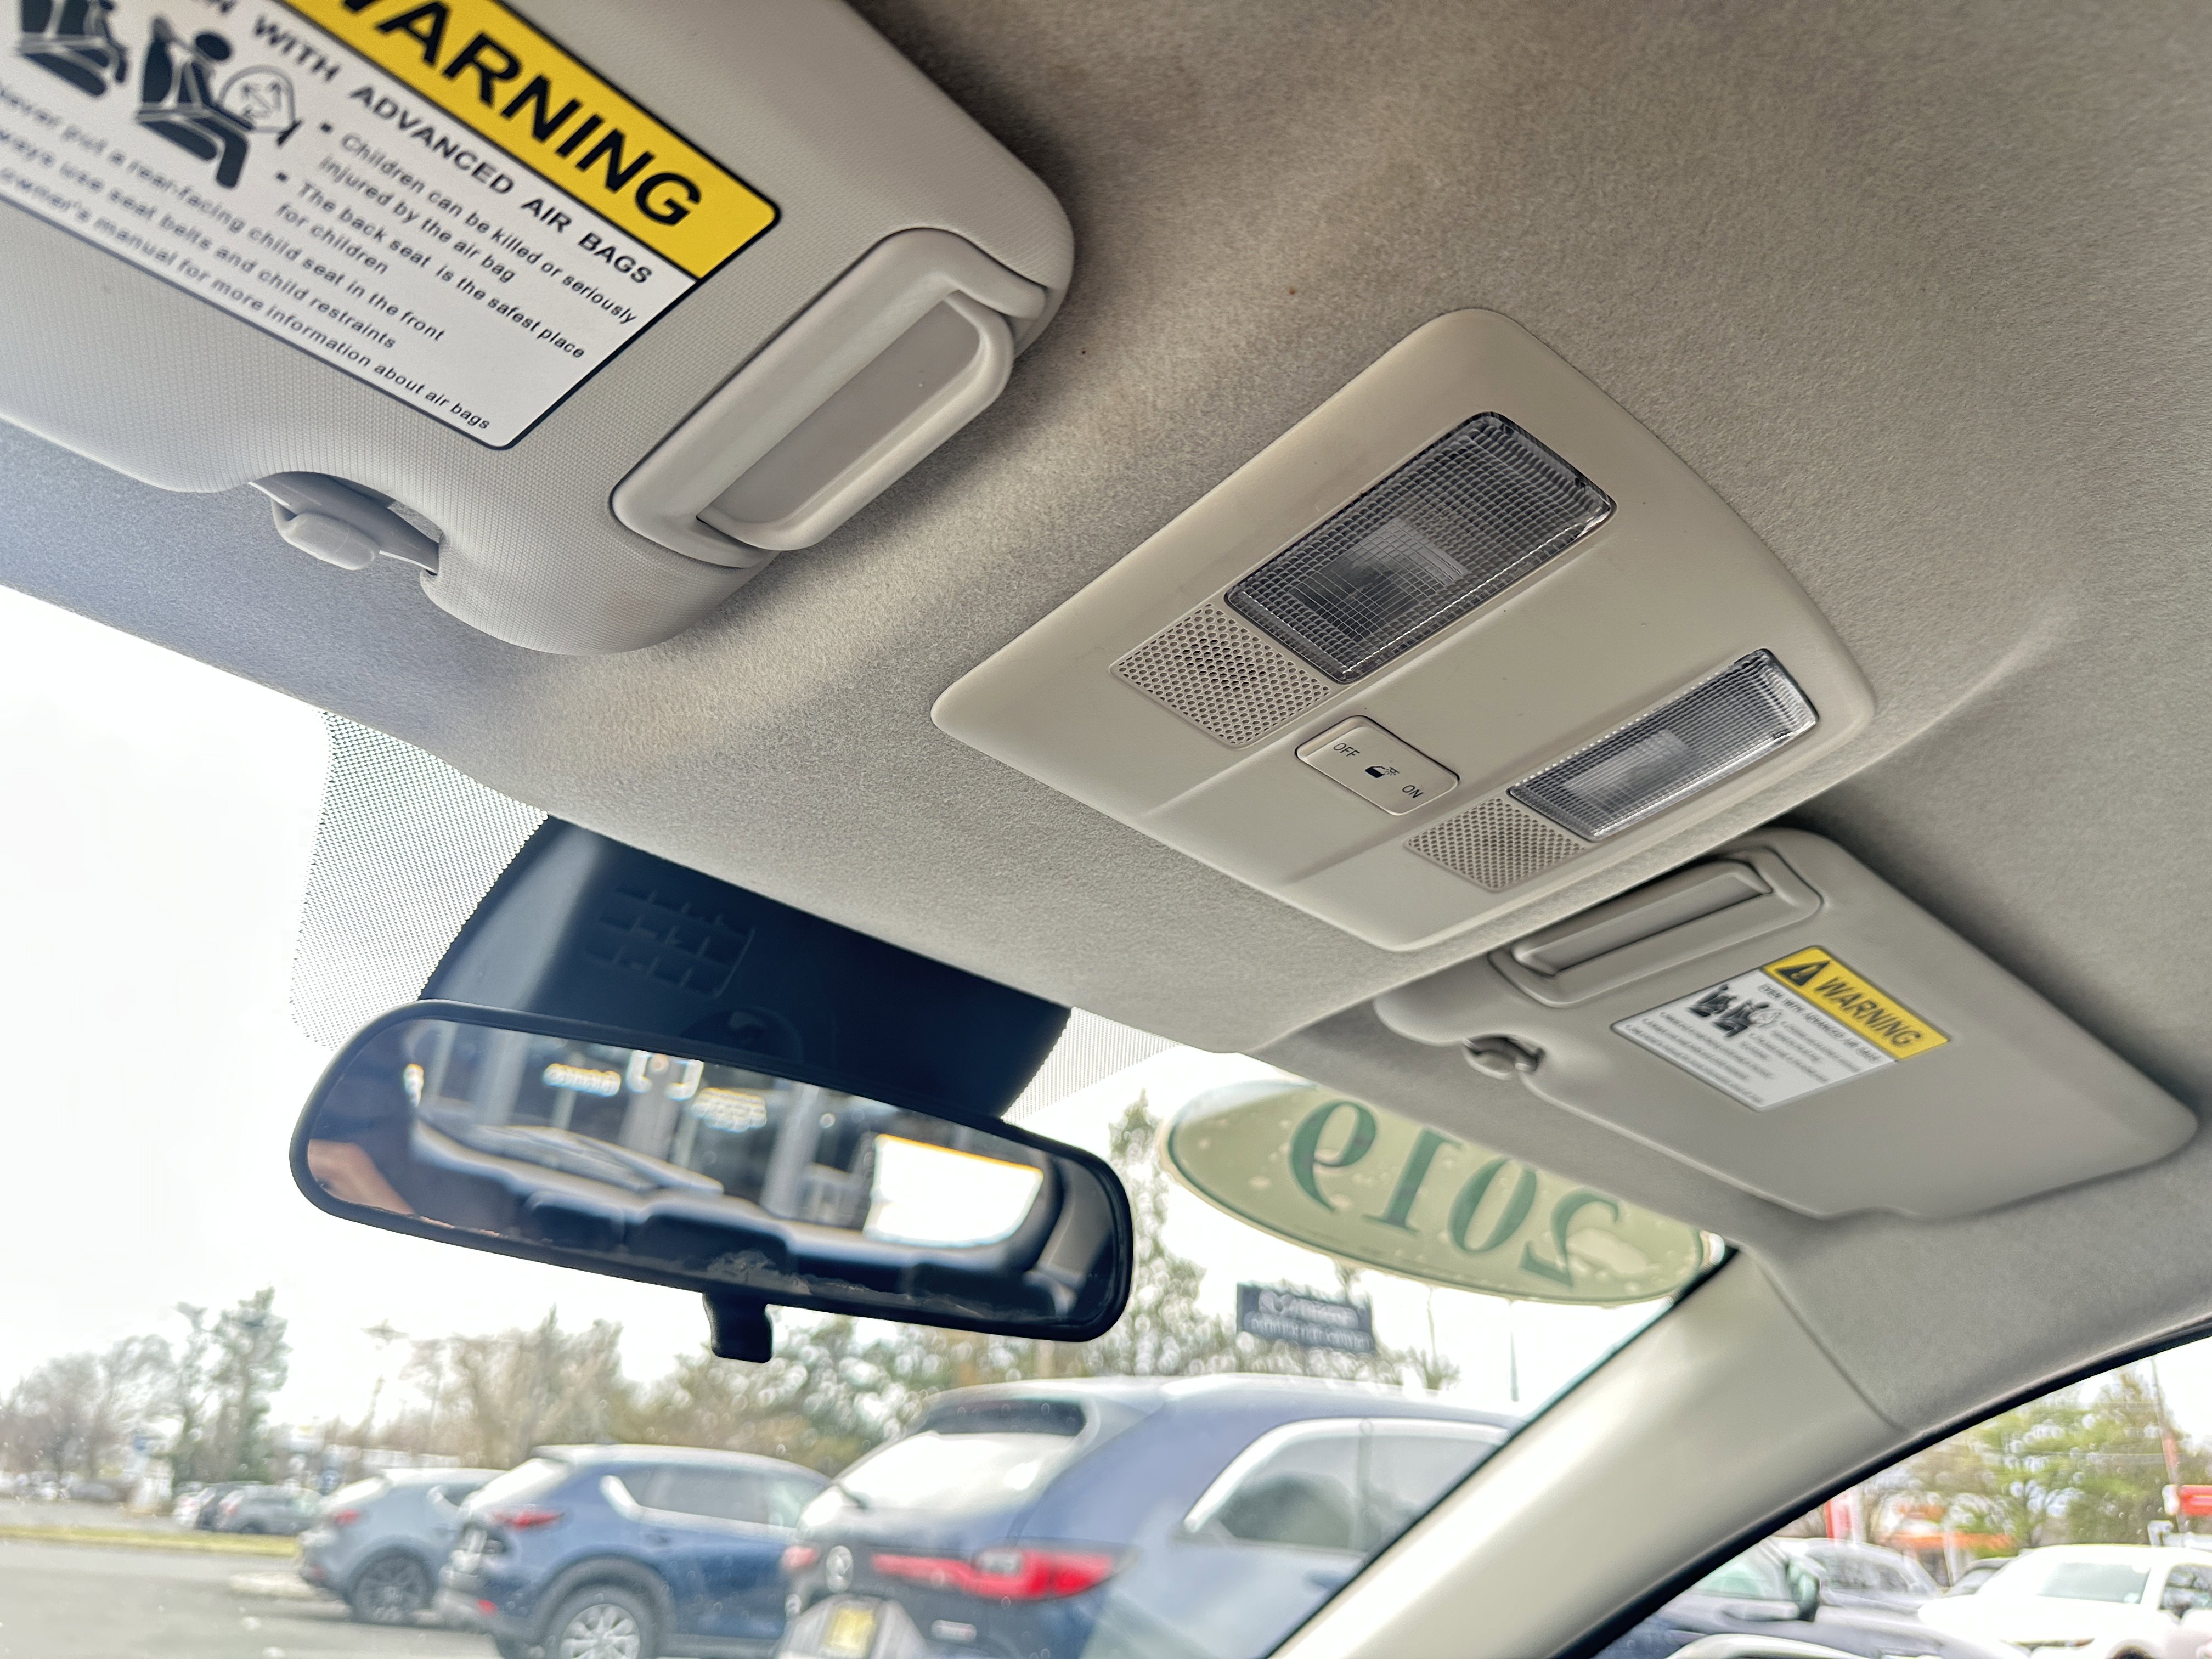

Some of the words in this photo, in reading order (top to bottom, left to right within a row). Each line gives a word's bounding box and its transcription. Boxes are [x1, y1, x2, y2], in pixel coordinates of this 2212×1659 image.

[255, 14, 341, 81] WITH
[349, 86, 515, 194] ADVANCED
[521, 198, 573, 234] AIR
[578, 232, 652, 284] BAGS
[343, 0, 703, 226] ARNING
[59, 161, 105, 191] use
[109, 187, 158, 219] seat
[159, 213, 212, 250] belts
[215, 247, 258, 273] and
[257, 269, 309, 301] child
[309, 297, 396, 349] restraints
[61, 124, 108, 155] put
[108, 149, 126, 166] a
[127, 160, 245, 233] rear-facing
[247, 227, 302, 261] child
[302, 257, 345, 285] seat
[346, 280, 365, 298] in
[367, 292, 399, 317] the
[399, 311, 445, 341] front
[276, 202, 309, 227] for
[311, 225, 388, 274] children
[299, 180, 336, 212] The
[339, 207, 386, 242] back
[389, 239, 431, 268] seat
[436, 263, 455, 282] is
[456, 277, 486, 300] the
[488, 297, 541, 332] safest
[537, 328, 584, 358] place
[319, 153, 394, 206] injured
[393, 201, 420, 223] by
[421, 218, 452, 242] the
[454, 240, 481, 259] air
[481, 255, 516, 284] bag
[341, 132, 425, 193] Children
[428, 191, 463, 217] can
[465, 212, 490, 234] be
[491, 227, 543, 264] killed
[541, 261, 563, 278] or
[562, 275, 637, 325] seriously
[93, 216, 178, 266] manual
[176, 258, 211, 282] for
[211, 279, 264, 311] more
[265, 304, 371, 367] information
[373, 362, 425, 395] about
[425, 392, 450, 407] air
[450, 402, 490, 430] bags
[1333, 743, 1360, 757] OFF
[1402, 785, 1423, 798] ON
[1814, 975, 1921, 1047] WARNING
